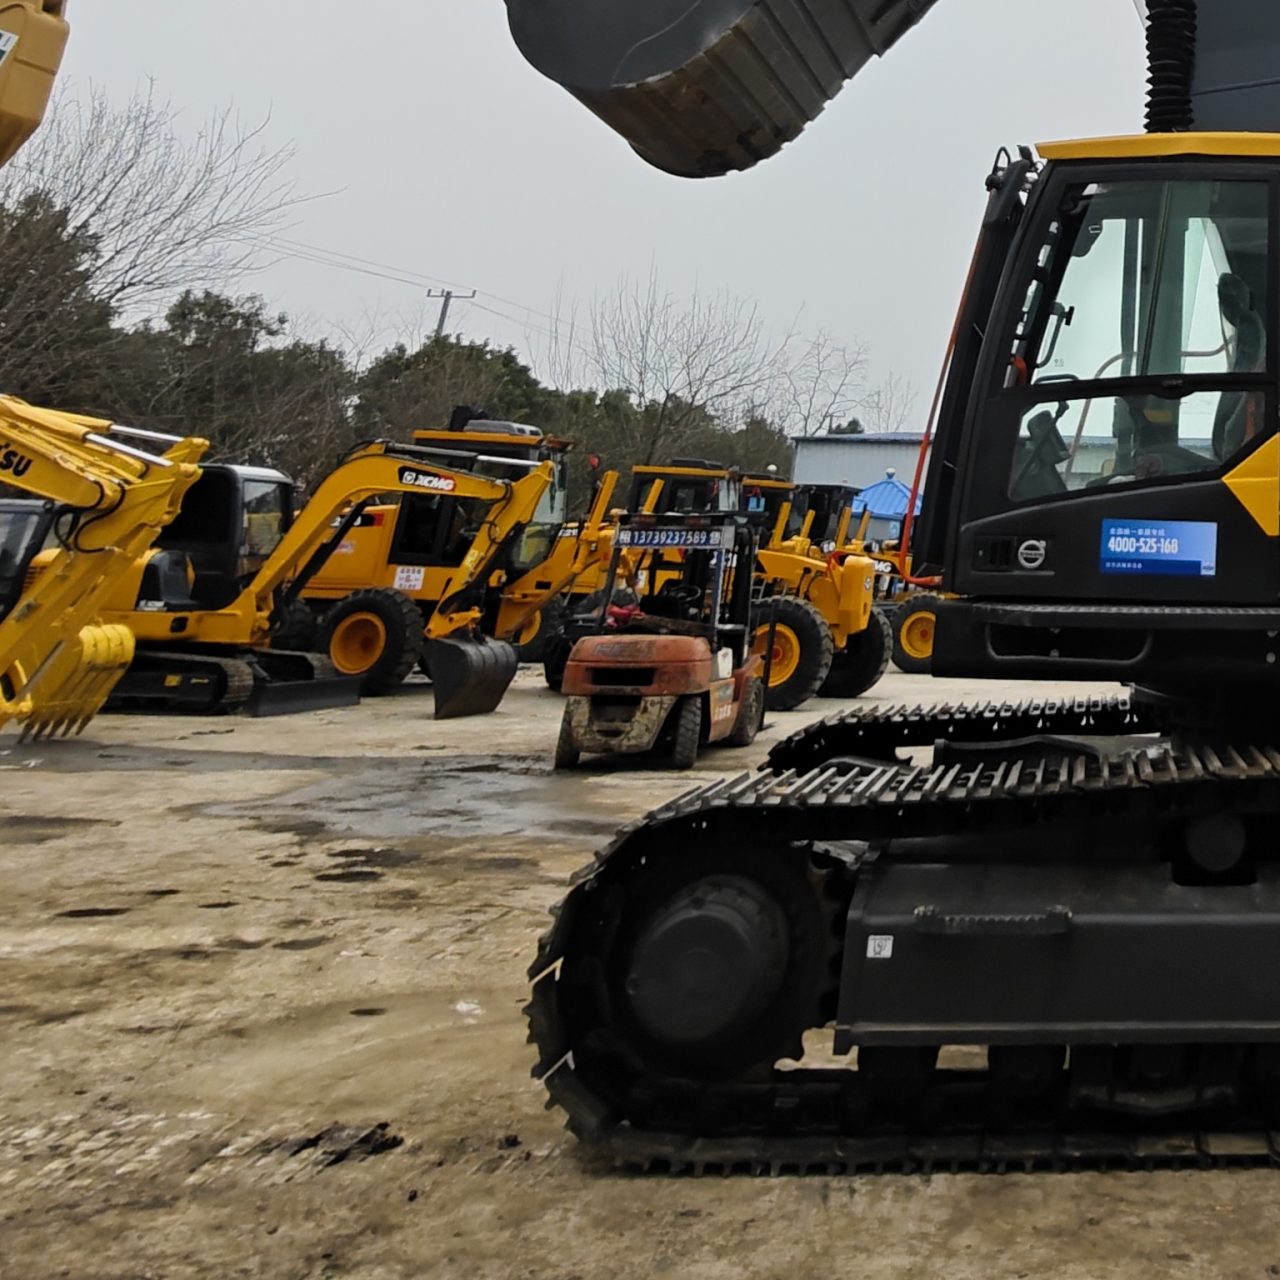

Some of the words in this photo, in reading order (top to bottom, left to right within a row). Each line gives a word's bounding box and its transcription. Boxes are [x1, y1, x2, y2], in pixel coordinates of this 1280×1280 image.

[415, 474, 455, 491] XCMG
[633, 530, 707, 545] 13739237589
[1108, 536, 1178, 554] 4000-525-168
